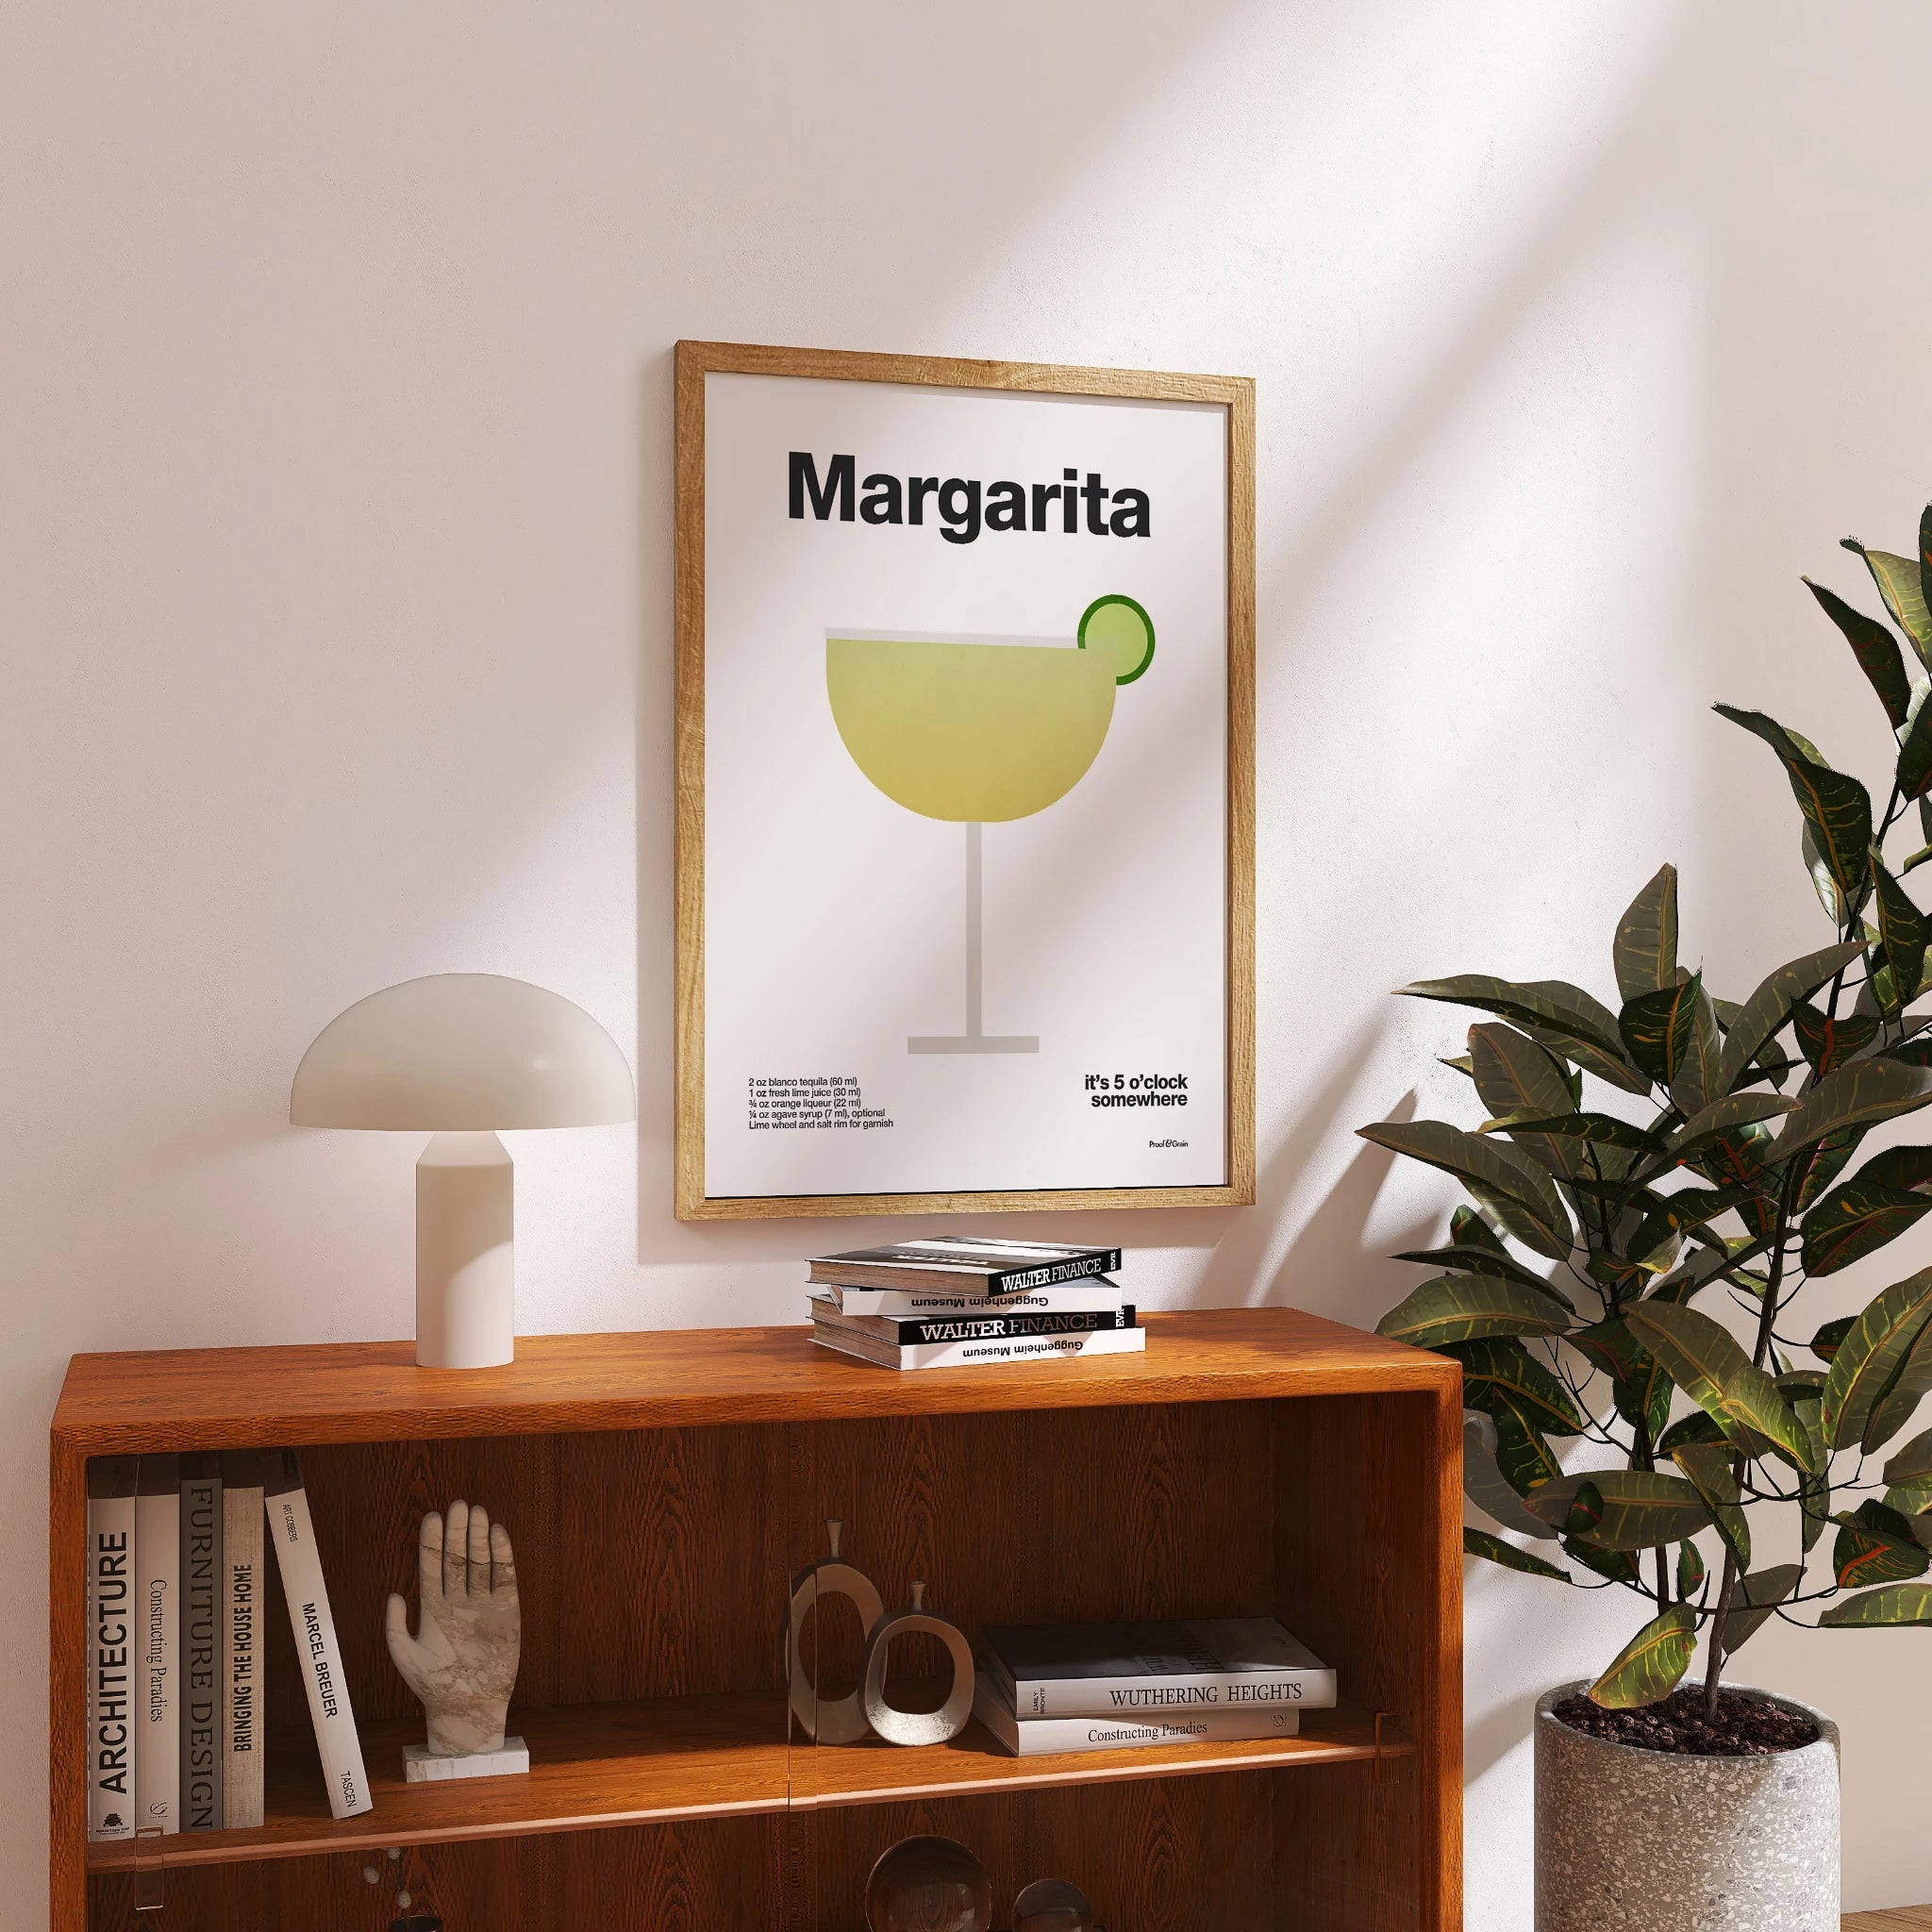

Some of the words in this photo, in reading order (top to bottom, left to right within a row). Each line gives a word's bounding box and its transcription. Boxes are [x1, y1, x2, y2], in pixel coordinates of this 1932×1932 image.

[789, 453, 1150, 544] Margarita
[769, 1078, 797, 1087] blanco
[800, 1077, 828, 1087] tequila
[830, 1077, 842, 1087] (60
[844, 1077, 858, 1087] ml)
[769, 1089, 790, 1097] fresh
[811, 1089, 831, 1098] juice
[834, 1088, 845, 1097] (30
[848, 1088, 860, 1097] ml)
[1114, 1074, 1124, 1090] 5
[772, 1100, 801, 1109] orange
[803, 1099, 832, 1108] liqueur
[834, 1099, 846, 1108] (22
[849, 1099, 860, 1108] ml)
[1091, 1091, 1188, 1107] somewhere
[749, 1121, 769, 1129] Lime
[817, 1120, 832, 1128] salt
[863, 1119, 893, 1129] garnish
[772, 1111, 797, 1120] agave
[799, 1110, 823, 1120] syrup
[825, 1109, 832, 1119] (7
[835, 1109, 849, 1119] ml),
[852, 1108, 885, 1118] optional
[1001, 1268, 1050, 1291] WALTER
[1052, 1258, 1102, 1282] FINANCE
[911, 1297, 965, 1308] Museum
[968, 1297, 1049, 1309] Guggenheim
[920, 1321, 1006, 1341] WALTER
[1009, 1314, 1098, 1336] FINANCE
[962, 1346, 1011, 1357] Museum
[1014, 1341, 1084, 1354] Guggenheim
[282, 1503, 291, 1519] ART
[287, 1516, 298, 1542] COBBERS
[191, 1485, 213, 1690] FURNITURE
[233, 1563, 251, 1601] HOME
[146, 1578, 167, 1663] Constructing
[233, 1605, 251, 1648] HOUSE
[98, 1531, 128, 1794] ARCHITECTURE
[233, 1652, 251, 1683] THE
[302, 1602, 323, 1661] MARCEL
[314, 1663, 338, 1719] BREUER
[150, 1666, 167, 1723] Paradies
[1109, 1687, 1218, 1707] WUTHERING
[1227, 1683, 1303, 1701] HEIGHTS
[233, 1686, 251, 1753] BRINGING
[1088, 1725, 1159, 1743] Constructing
[1161, 1721, 1208, 1737] Paradies
[191, 1704, 213, 1829] DESIGN
[341, 1771, 358, 1807] TASCEN
